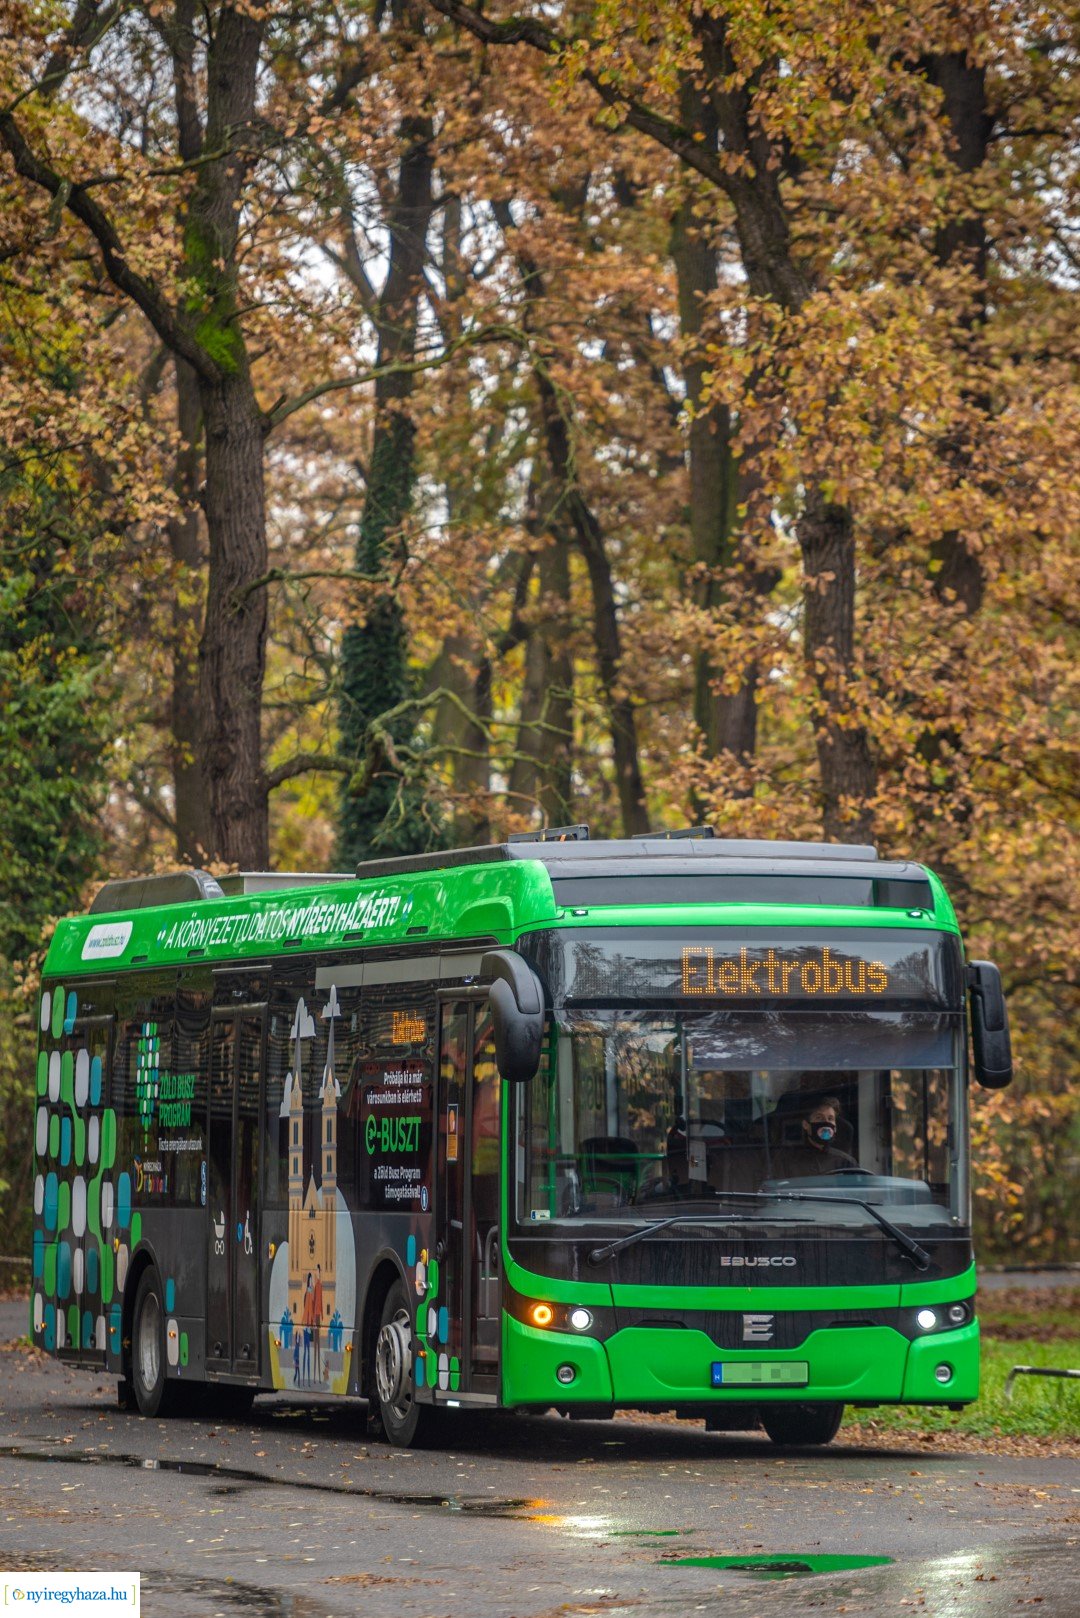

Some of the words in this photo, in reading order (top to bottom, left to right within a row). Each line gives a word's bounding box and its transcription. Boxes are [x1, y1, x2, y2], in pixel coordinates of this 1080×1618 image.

[163, 921, 178, 949] A
[681, 946, 889, 994] Elektrobus
[177, 1074, 195, 1099] BUSZ
[403, 1070, 409, 1084] ki
[412, 1069, 423, 1084] már
[366, 1090, 397, 1105] városunkban
[396, 1090, 402, 1104] is
[401, 1088, 422, 1103] elérhető
[158, 1102, 191, 1127] PROGRAM
[377, 1165, 389, 1179] Zöld
[388, 1166, 400, 1179] Busz
[400, 1166, 421, 1182] Program
[720, 1256, 797, 1267] EBUSCO
